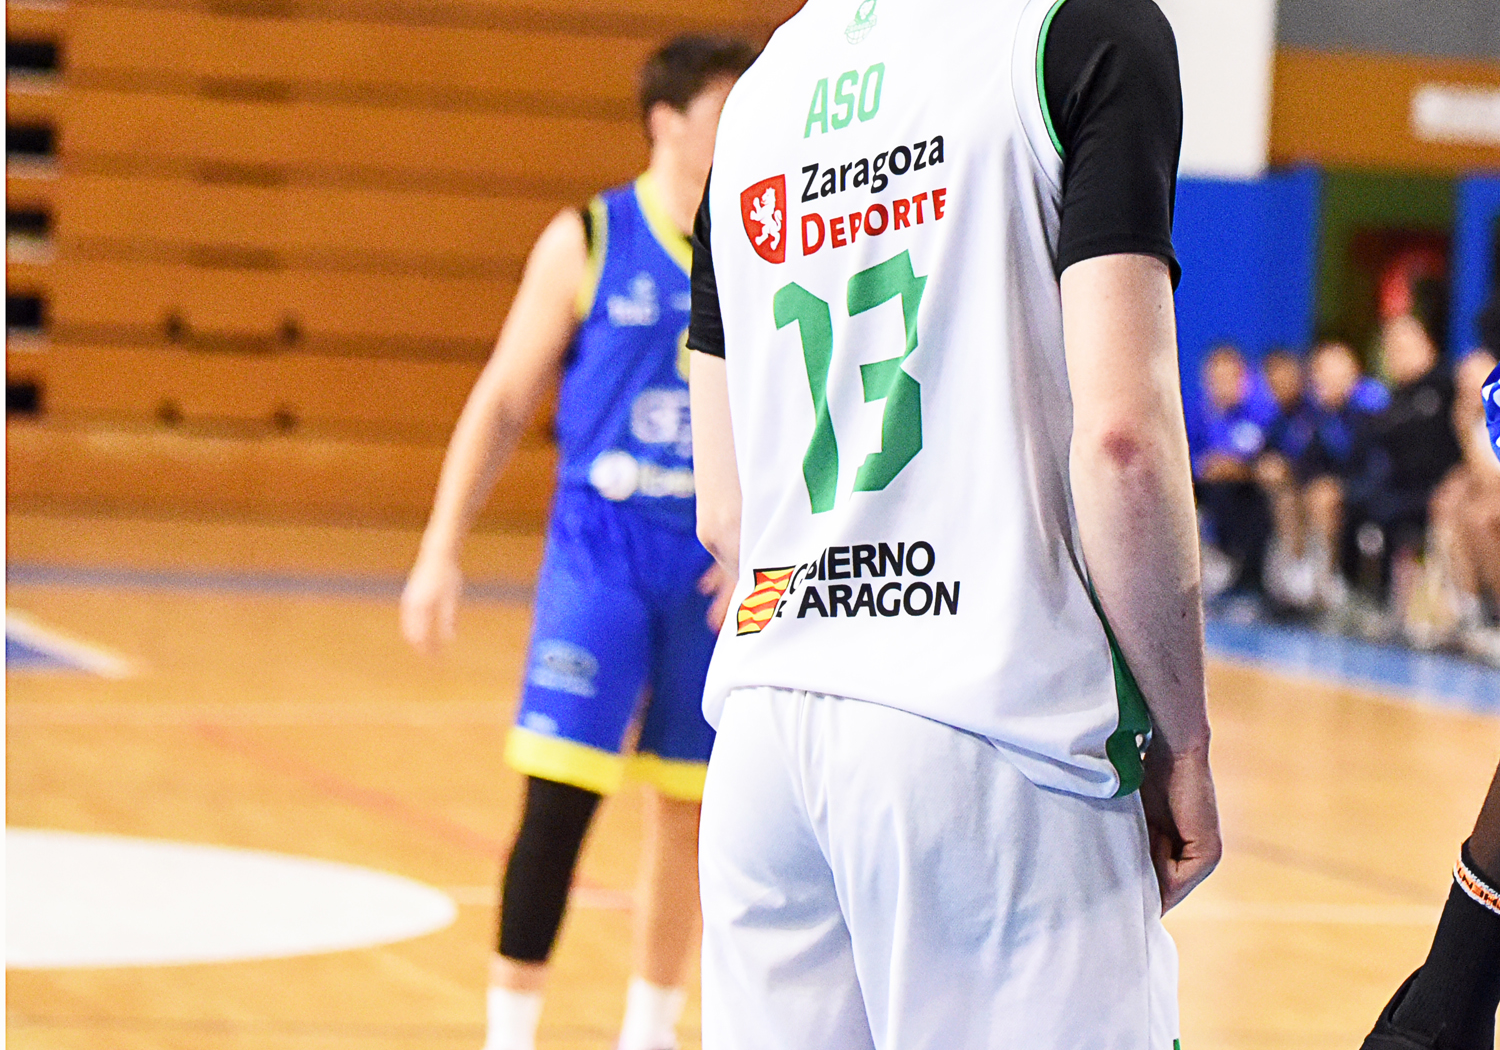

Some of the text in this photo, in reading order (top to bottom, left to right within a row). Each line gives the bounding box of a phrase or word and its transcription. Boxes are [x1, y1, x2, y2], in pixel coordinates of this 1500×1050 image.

[803, 61, 885, 139] ASO
[801, 135, 945, 204] Zaragoza
[801, 187, 947, 256] DEPORTE
[773, 248, 929, 515] 13
[797, 581, 961, 619] ARAGON
